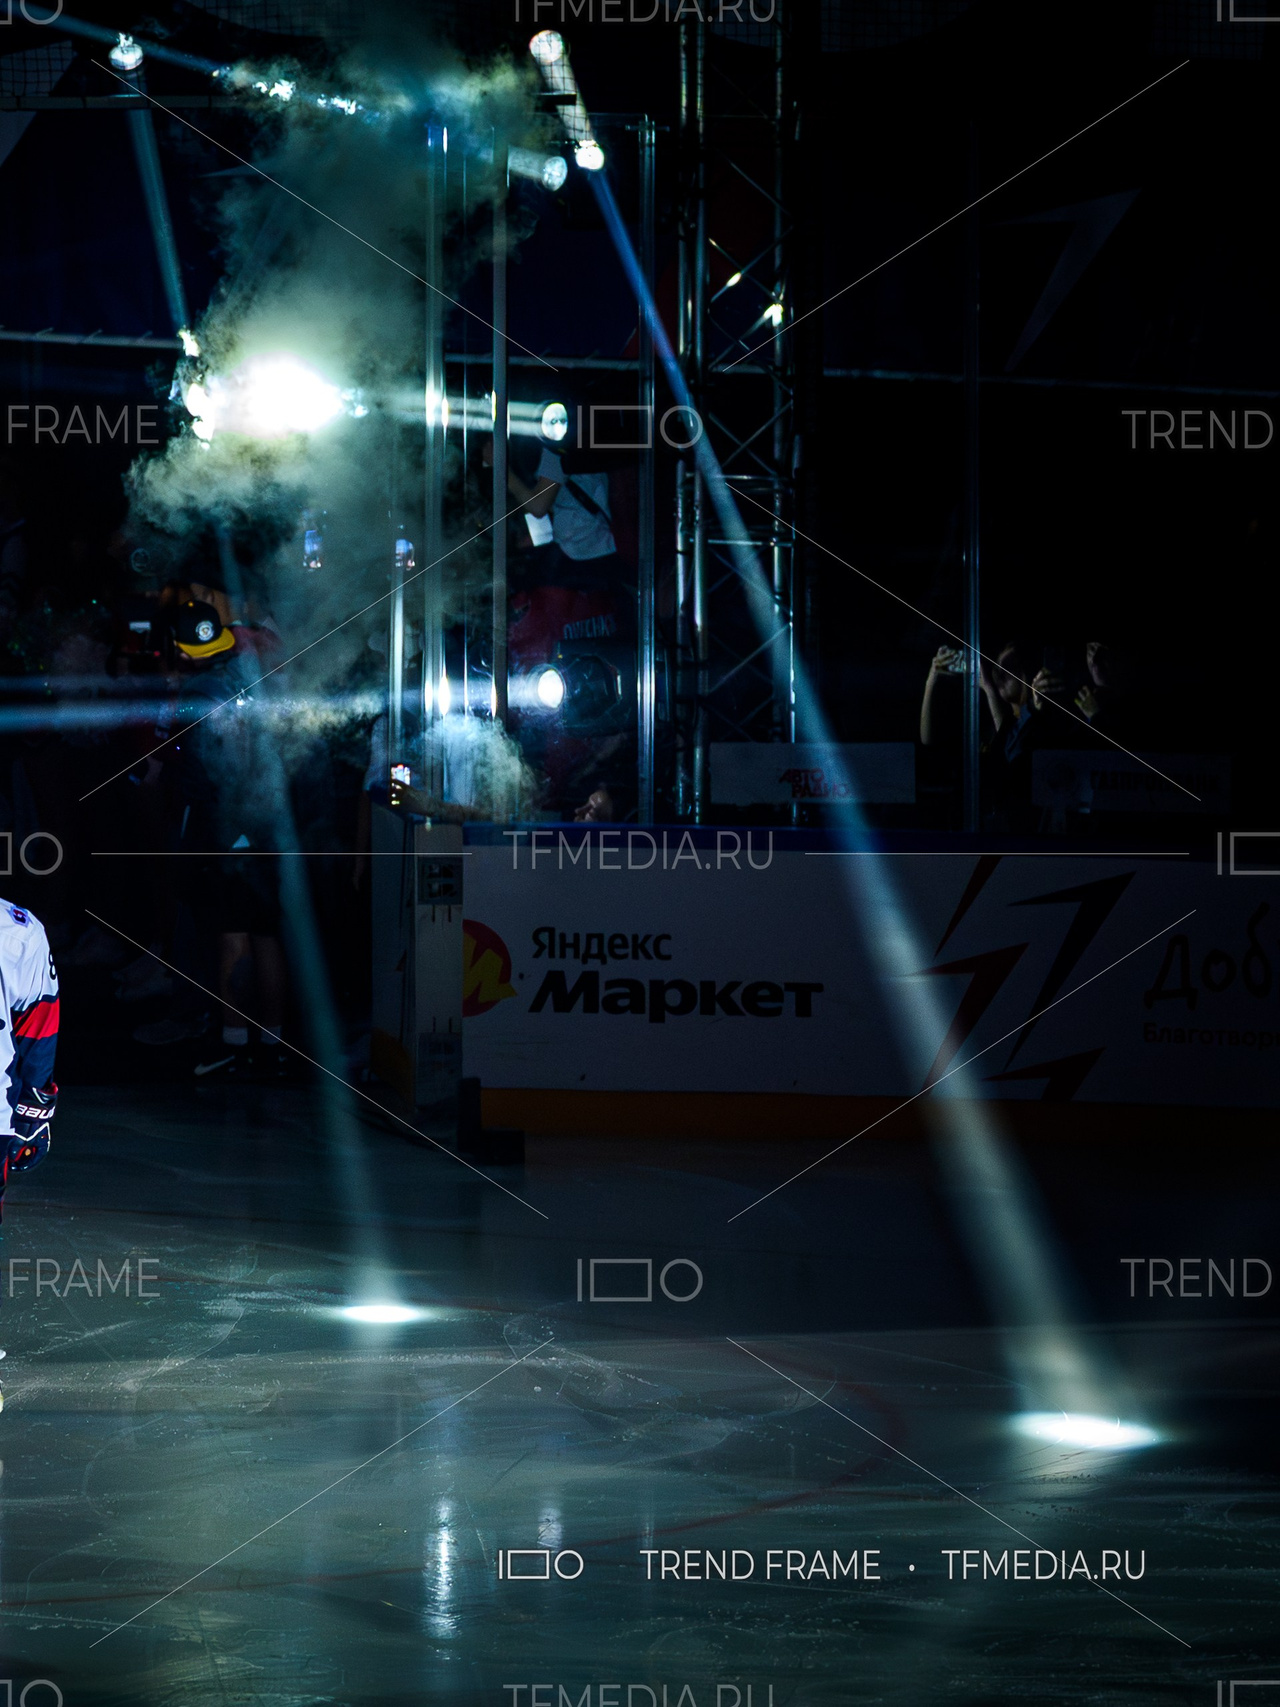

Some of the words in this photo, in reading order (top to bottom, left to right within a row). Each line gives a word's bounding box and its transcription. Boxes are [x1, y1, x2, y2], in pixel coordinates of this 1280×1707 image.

[532, 927, 672, 964] Яндекс
[1144, 902, 1280, 1010] Доб
[529, 970, 824, 1023] Маркет
